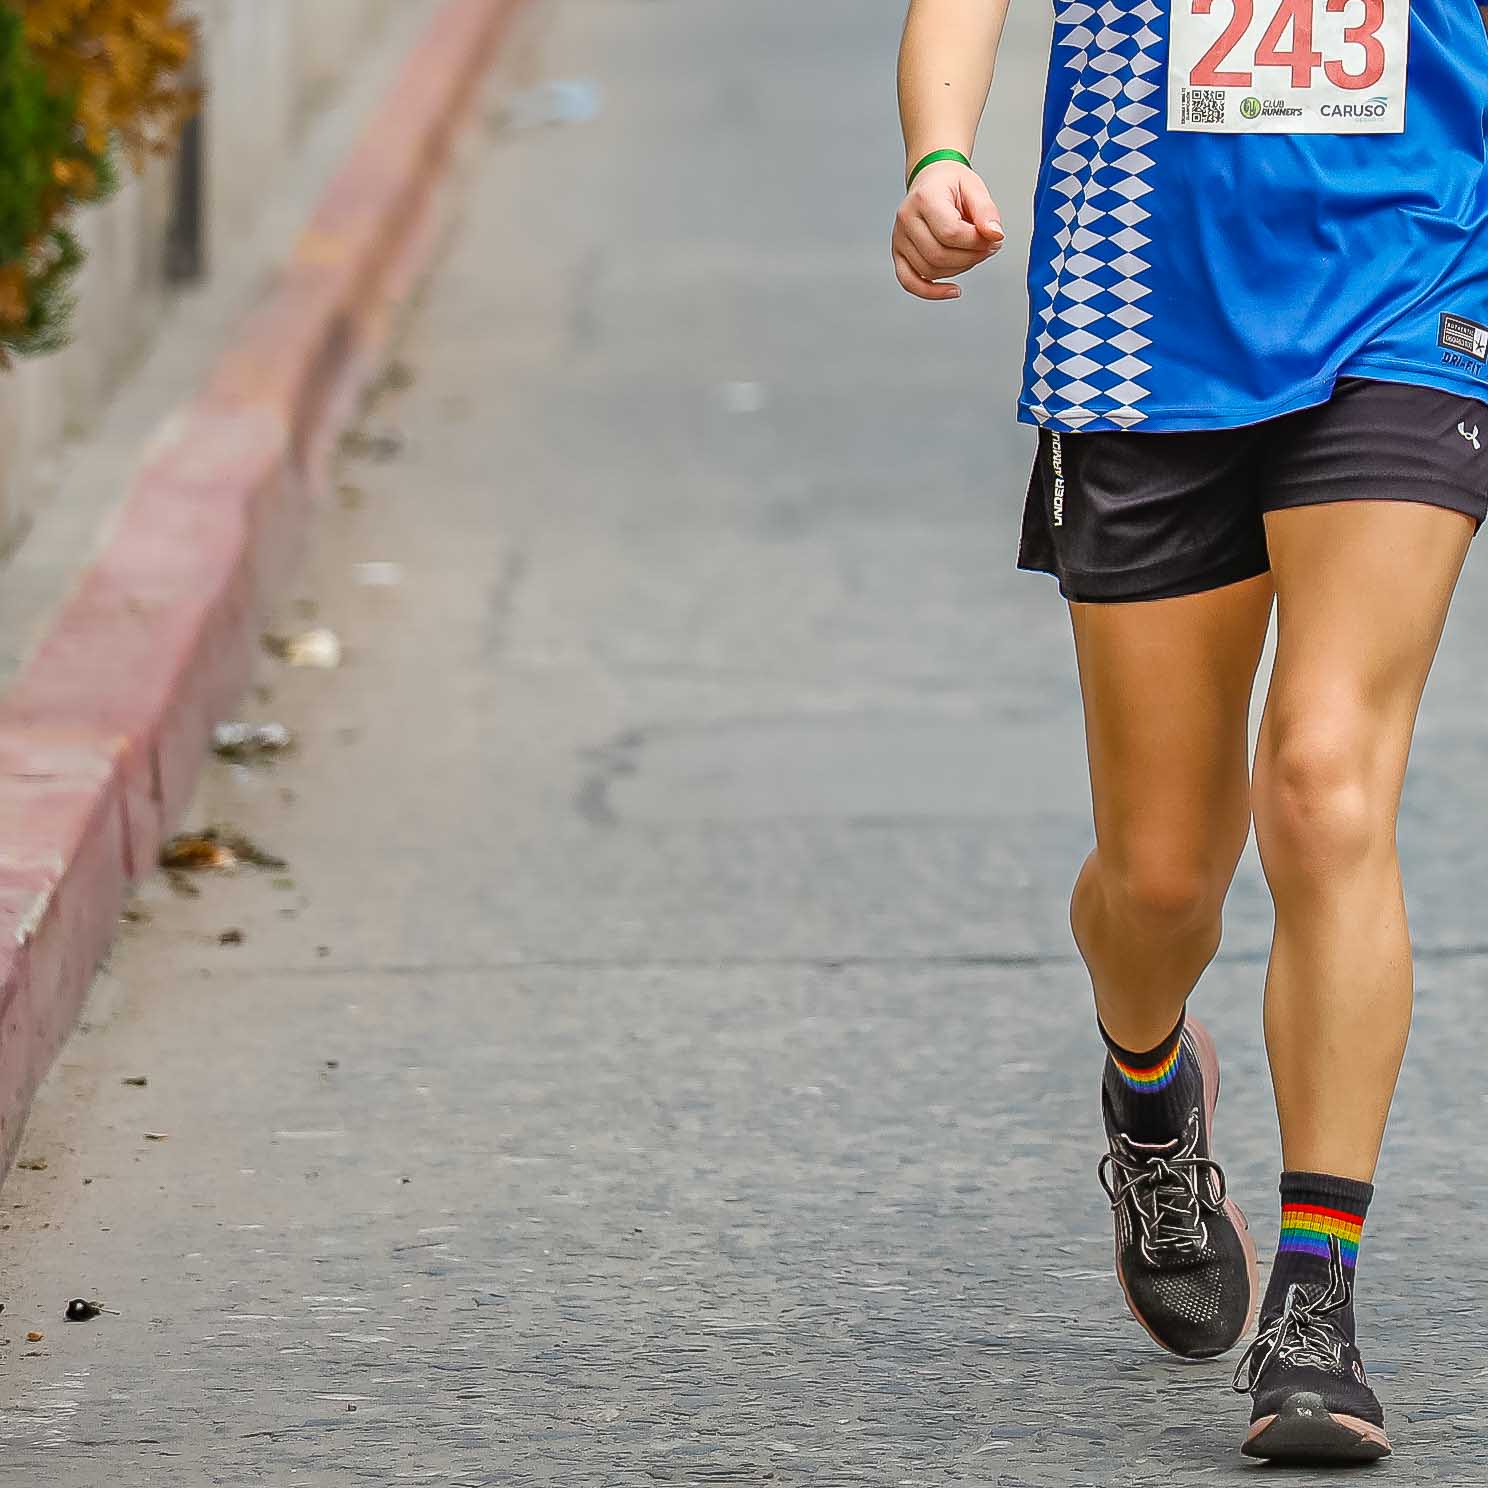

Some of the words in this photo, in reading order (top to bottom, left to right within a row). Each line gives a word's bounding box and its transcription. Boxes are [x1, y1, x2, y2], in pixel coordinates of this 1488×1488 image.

[1262, 100, 1285, 109] CLUB
[1320, 104, 1386, 118] CARUSO
[1053, 478, 1064, 526] UNDER
